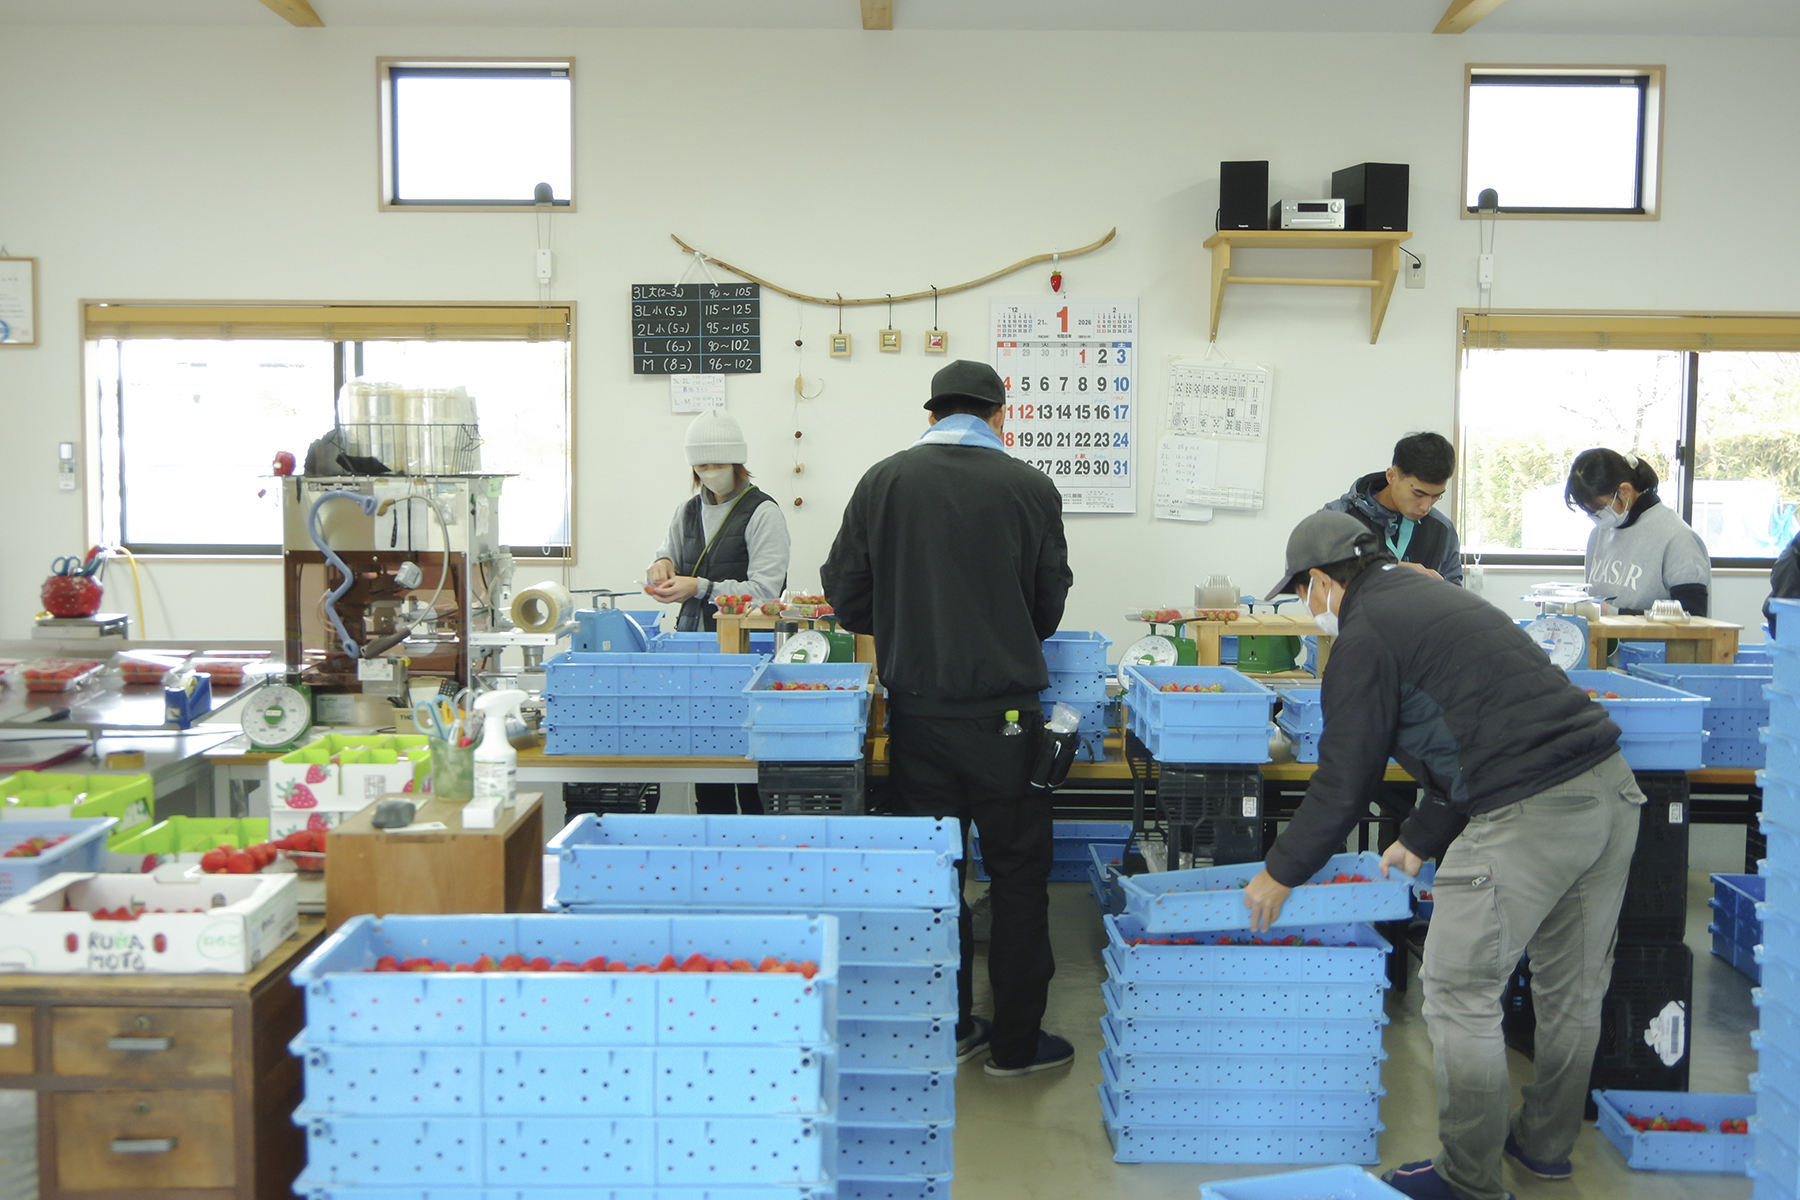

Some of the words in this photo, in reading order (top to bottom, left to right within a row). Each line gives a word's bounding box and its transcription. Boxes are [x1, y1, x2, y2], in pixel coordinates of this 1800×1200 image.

[1056, 306, 1068, 333] 1
[1080, 349, 1085, 363] 1
[1098, 349, 1107, 363] 2
[1117, 349, 1126, 364] 3
[1021, 377, 1030, 391] 5
[1040, 377, 1049, 391] 6
[1059, 377, 1068, 391] 7
[1078, 377, 1087, 391] 8
[1097, 377, 1107, 391] 9
[1114, 377, 1129, 391] 10
[1018, 404, 1034, 419] 12
[1037, 404, 1053, 419] 13
[1056, 404, 1071, 419] 14
[1075, 404, 1091, 419] 15
[1094, 404, 1110, 419] 16
[1113, 404, 1129, 419] 17
[1018, 432, 1034, 447] 19
[1037, 432, 1053, 447] 20
[1057, 432, 1070, 447] 21
[1075, 432, 1091, 447] 22
[1094, 432, 1110, 447] 23
[1113, 432, 1129, 447] 24
[1038, 460, 1053, 475] 27
[1056, 460, 1071, 475] 28
[1075, 460, 1091, 475] 29
[1093, 460, 1110, 475] 30
[1113, 460, 1128, 475] 31
[87, 952, 145, 970] MOTO
